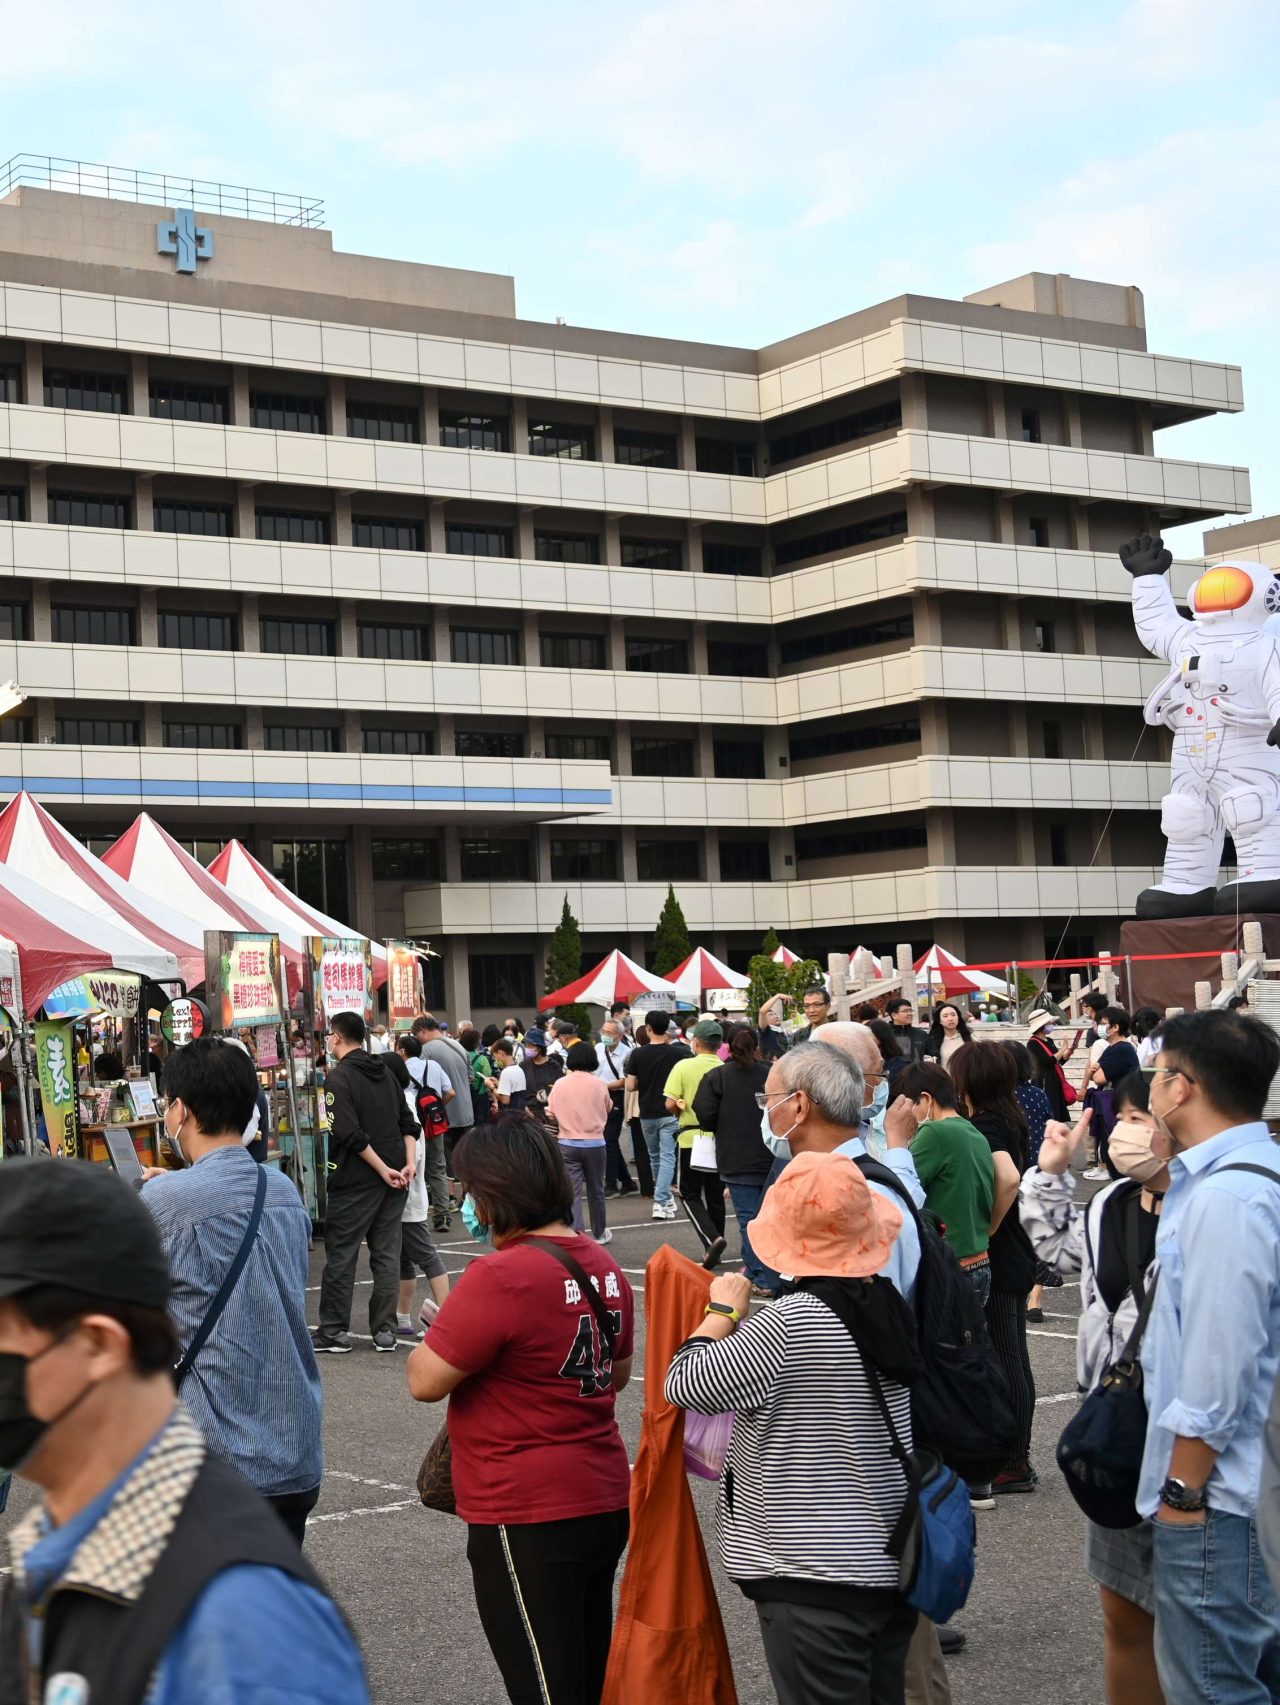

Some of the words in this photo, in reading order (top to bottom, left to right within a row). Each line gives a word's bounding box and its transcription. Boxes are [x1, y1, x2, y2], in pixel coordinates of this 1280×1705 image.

[239, 950, 266, 977] 檸檬愛玉
[323, 961, 364, 991] 起司馬鈴薯
[233, 982, 273, 1010] 黑糖珍珠鮮奶
[328, 995, 345, 1009] Cheese
[345, 995, 362, 1009] Potato
